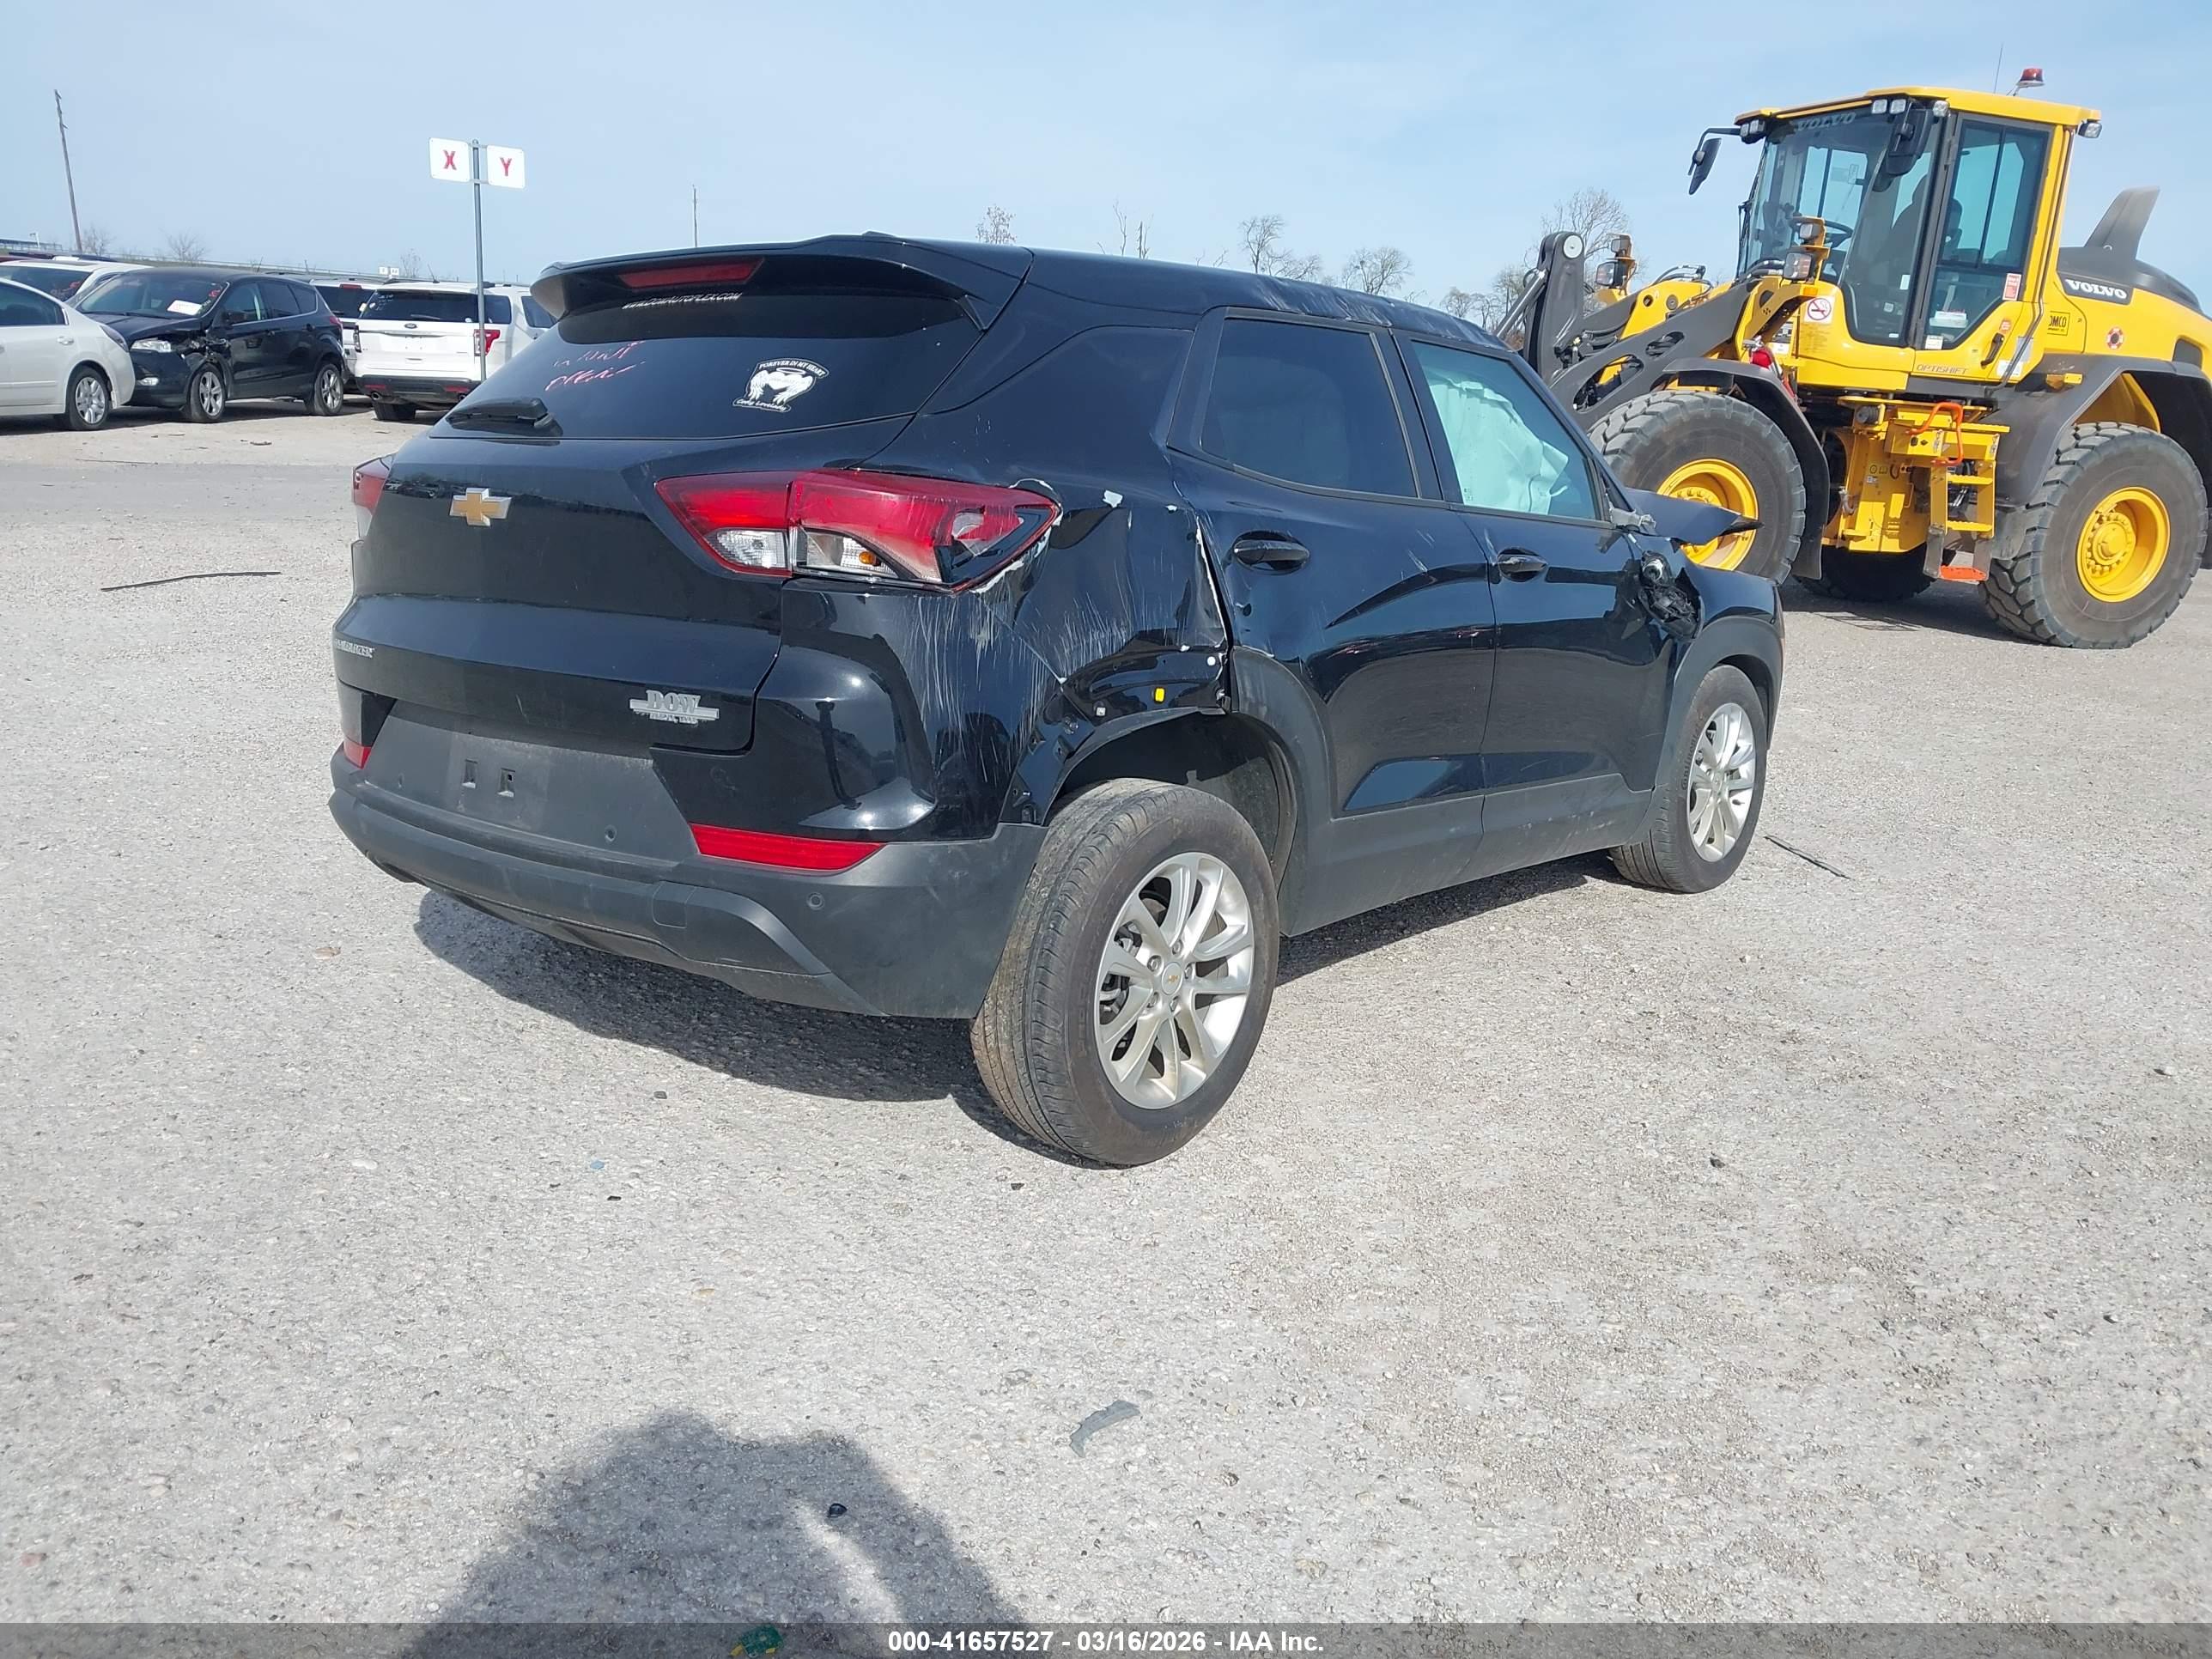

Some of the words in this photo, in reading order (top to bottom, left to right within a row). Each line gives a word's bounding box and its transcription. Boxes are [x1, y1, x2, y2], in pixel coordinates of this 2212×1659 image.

[1796, 112, 1856, 131] VOLVO
[442, 149, 457, 170] X
[500, 157, 513, 177] Y
[2064, 278, 2128, 300] VOLVO
[759, 361, 789, 369] FOREVER
[807, 364, 826, 376] HEART
[1916, 364, 1969, 375] OPTISHIFT
[646, 690, 702, 714] DOW
